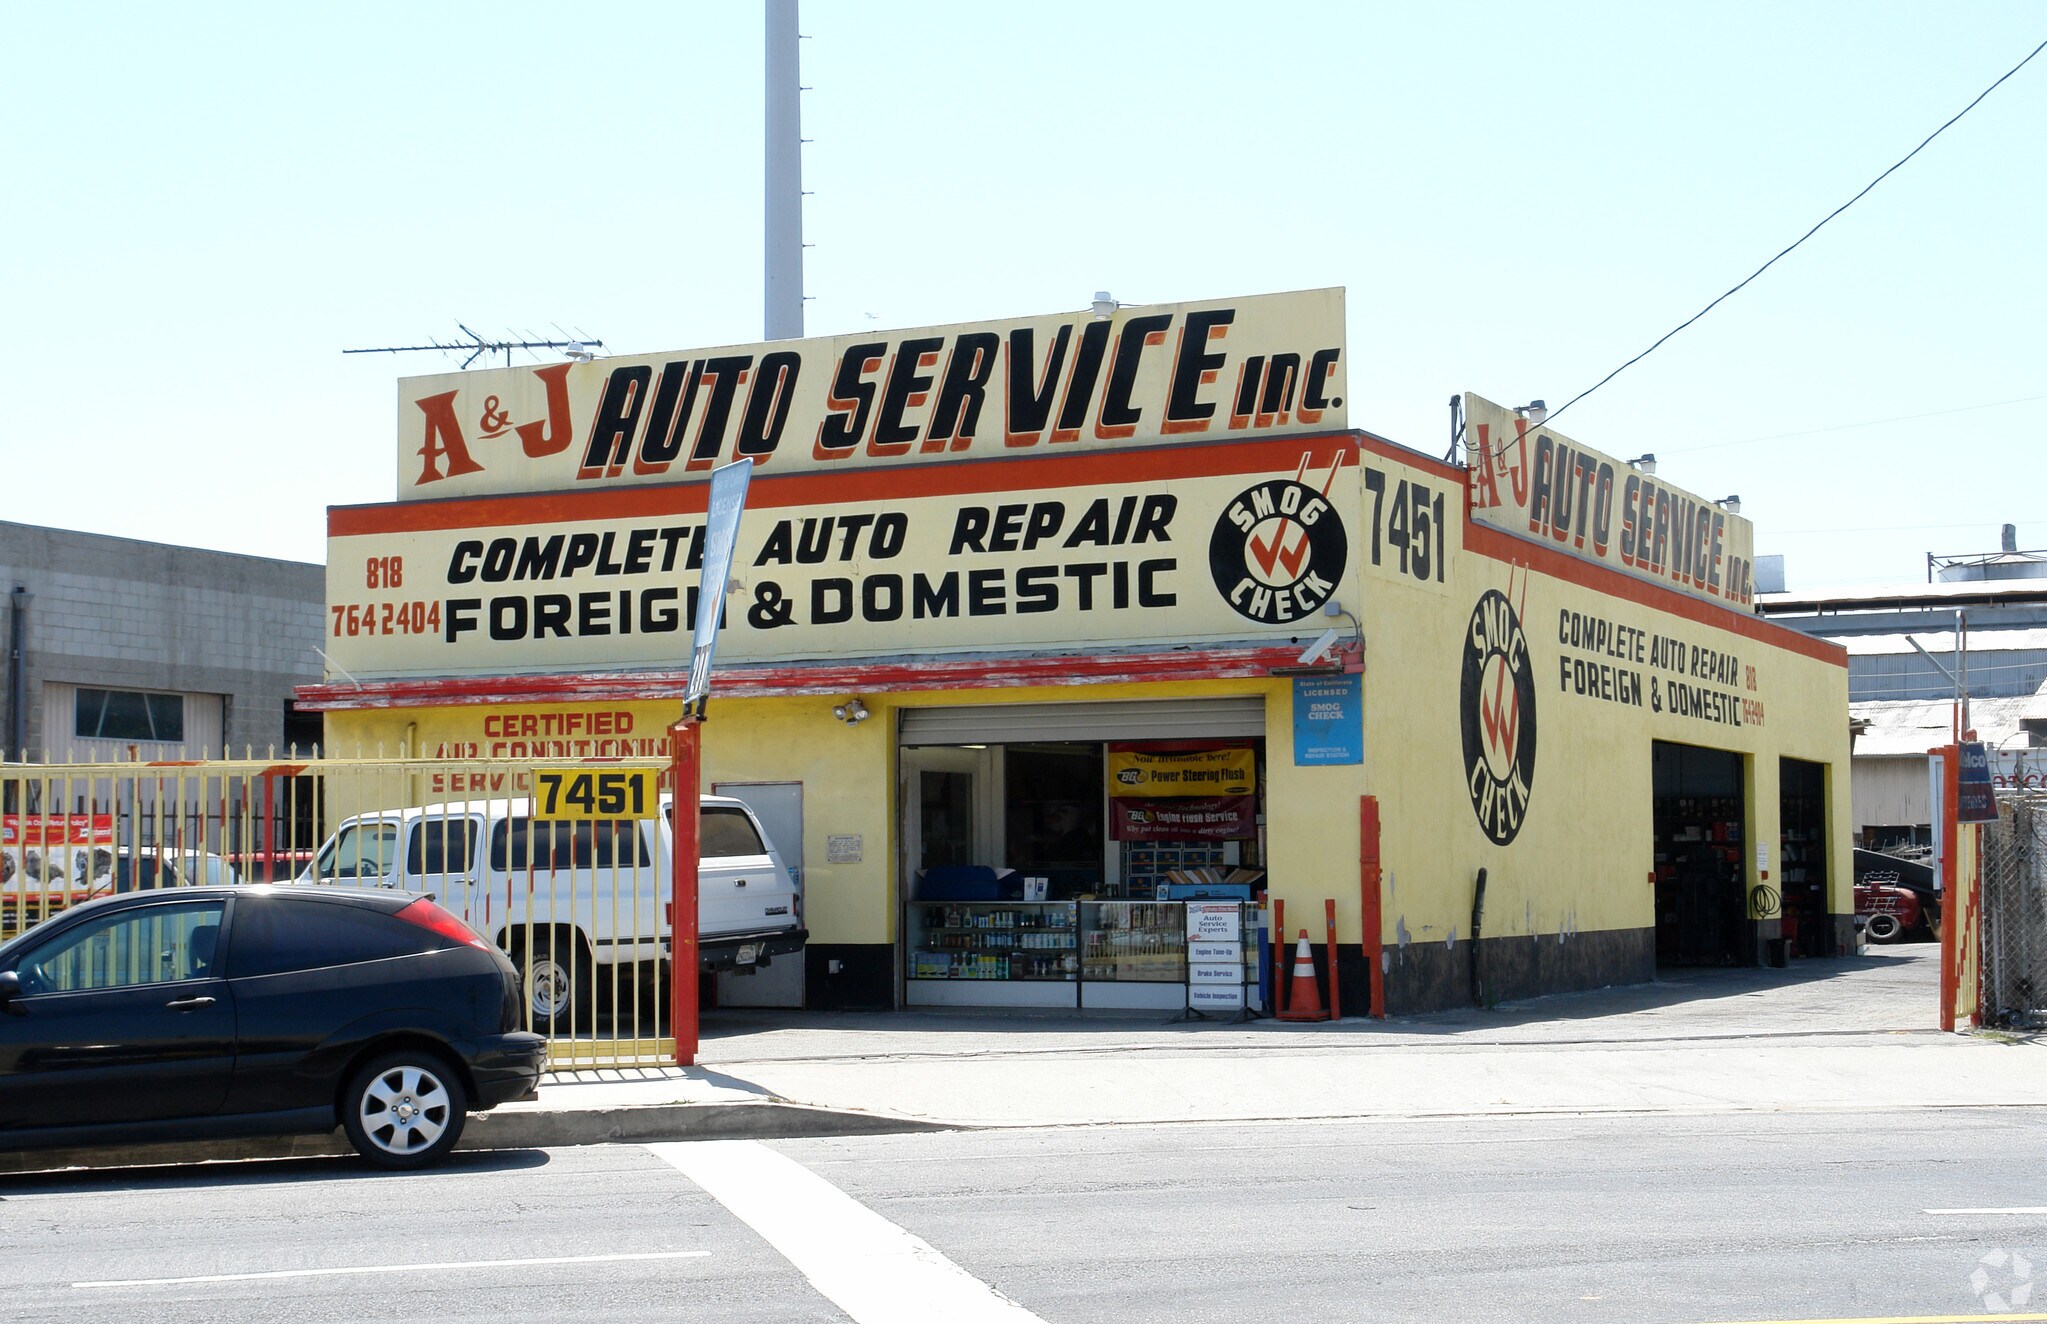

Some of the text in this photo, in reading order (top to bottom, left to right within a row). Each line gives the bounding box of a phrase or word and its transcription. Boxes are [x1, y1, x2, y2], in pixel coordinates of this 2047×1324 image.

[415, 390, 485, 486] A
[477, 395, 514, 440] &
[514, 361, 574, 458] J
[576, 352, 801, 480] AUTO
[813, 309, 1236, 461] SERVICE
[1228, 485, 1328, 533] SMOG
[1365, 467, 1444, 583] 7451
[1476, 424, 1502, 508] A
[1496, 437, 1510, 478] &
[1510, 418, 1528, 508] J
[1529, 434, 1615, 557] AUTO
[1620, 474, 1725, 596] SERVICE
[753, 512, 908, 567] AUTO
[949, 494, 1179, 556] REPAIR
[366, 556, 402, 589] 818
[747, 581, 797, 630] &
[811, 558, 1177, 625] DOMESTIC
[1230, 569, 1333, 620] CHECK
[1472, 597, 1526, 673] SMOG
[1559, 608, 1738, 687] COMPLETE AUTO REPAIR
[1304, 689, 1348, 697] LICENSED
[1310, 703, 1341, 712] SMOG
[1560, 655, 1742, 727] FOREIGN & DOMESTIC
[484, 711, 633, 738] CERTIFIED
[1308, 711, 1345, 720] CHECK
[492, 738, 673, 759] CONDITIONIN
[432, 772, 529, 793] SERVIC
[540, 773, 645, 815] 7451
[1151, 769, 1180, 782] Power
[1183, 769, 1219, 783] Steering
[1221, 768, 1245, 781] Flush
[1156, 811, 1181, 823] Engine
[1205, 811, 1238, 822] Service
[1471, 756, 1529, 838] CHECK
[1195, 949, 1211, 957] Engine
[1212, 992, 1238, 1000] Inspection
